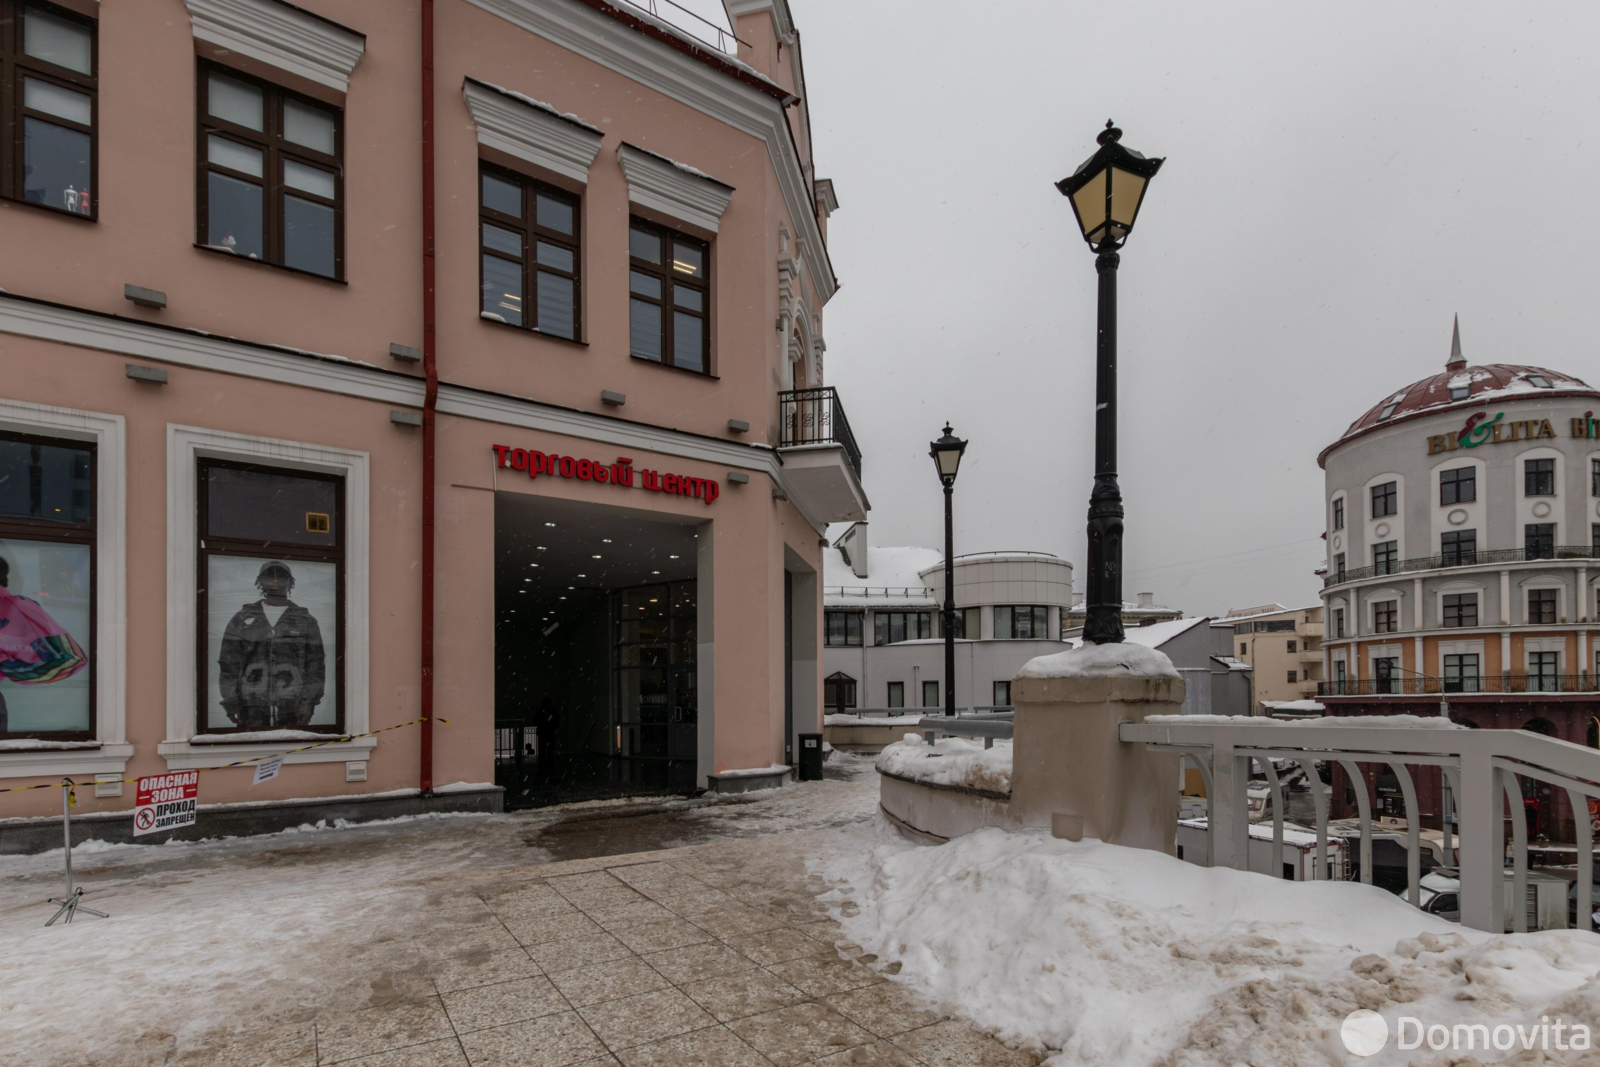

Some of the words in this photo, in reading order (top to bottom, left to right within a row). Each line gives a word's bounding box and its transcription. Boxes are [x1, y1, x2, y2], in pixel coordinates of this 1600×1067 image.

[493, 444, 633, 487] торговый
[642, 468, 720, 505] центр
[140, 772, 197, 792] ОПАСНАЯ
[151, 788, 184, 803] ЗОНА
[156, 799, 195, 817] ПРОХОД
[155, 813, 195, 828] ЗАПРЕЩЕН
